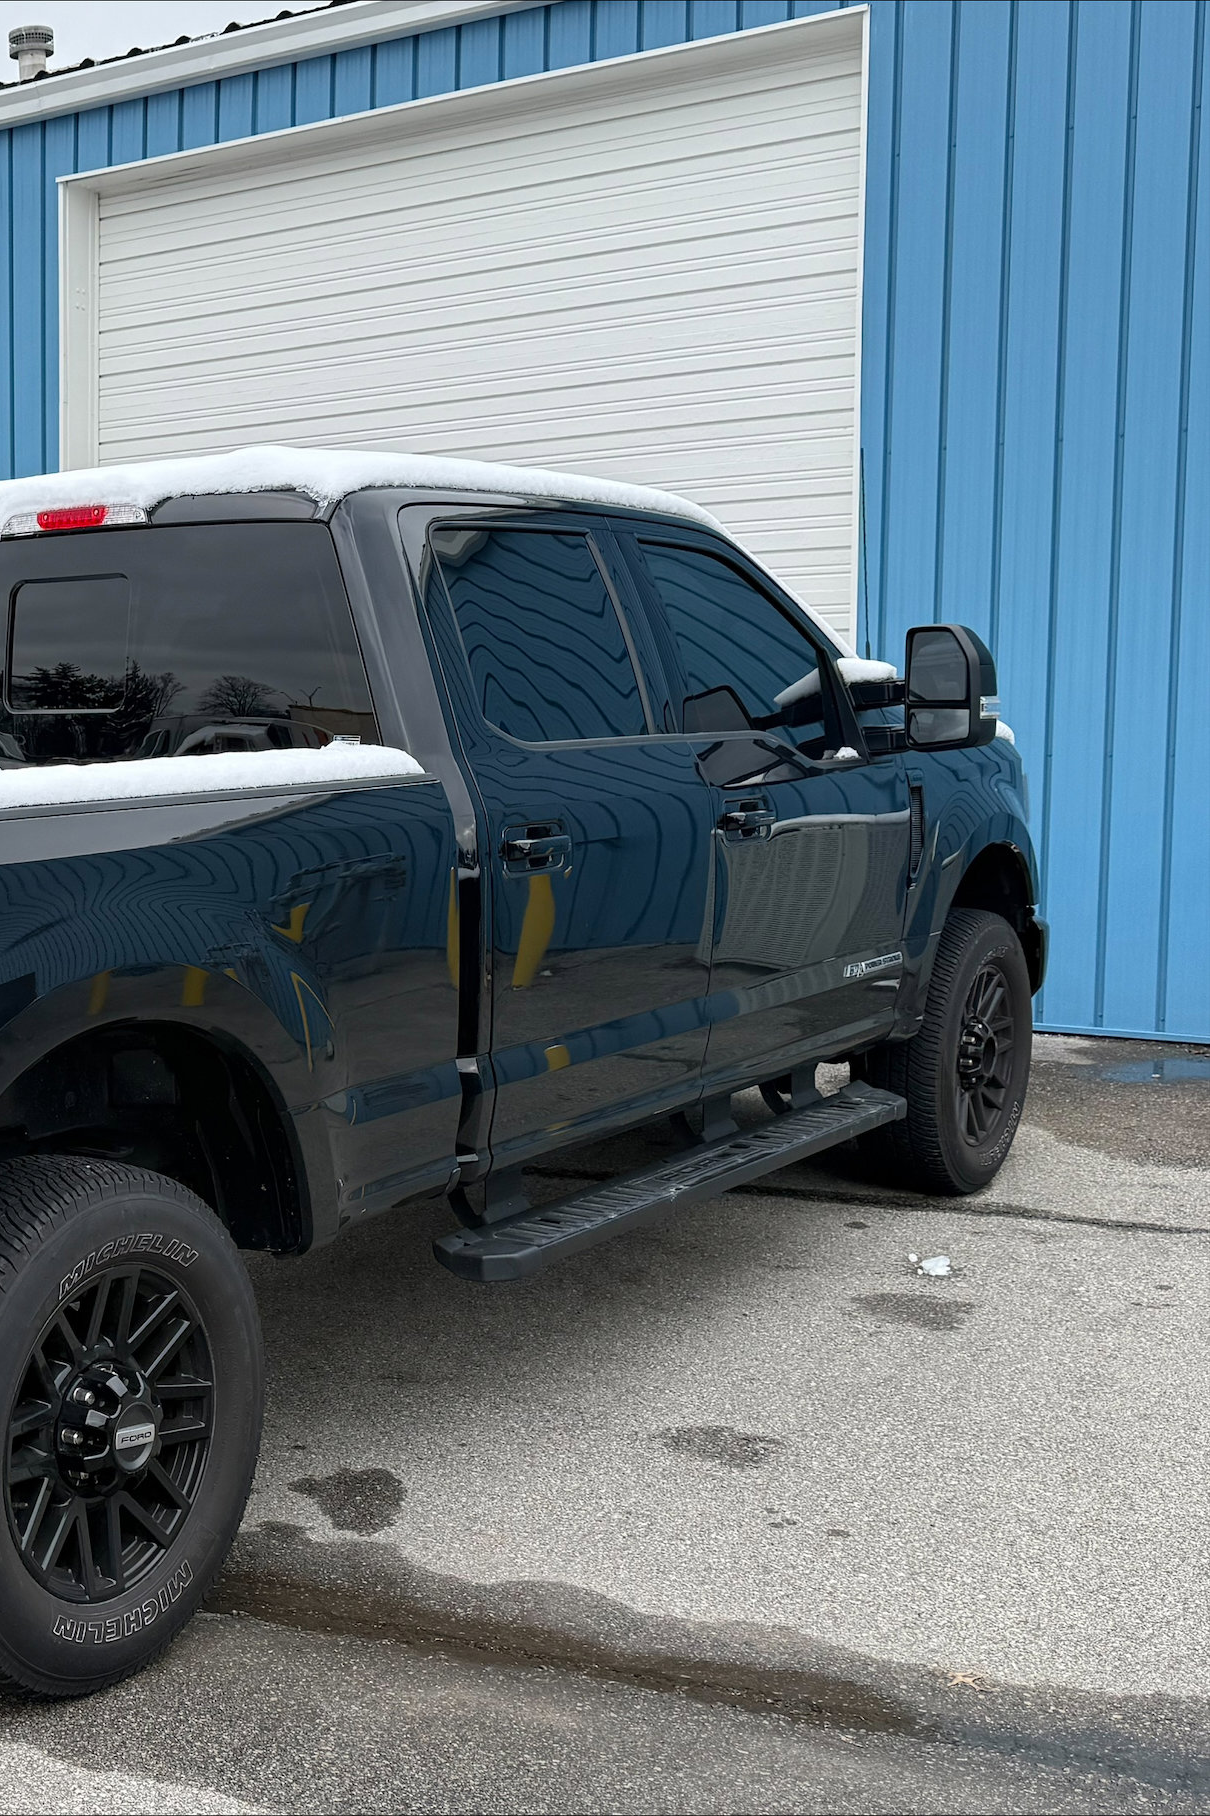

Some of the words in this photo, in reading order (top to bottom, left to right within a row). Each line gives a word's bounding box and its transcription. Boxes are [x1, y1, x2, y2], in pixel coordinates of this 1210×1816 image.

[58, 1233, 199, 1301] MICHELIN
[121, 1431, 152, 1444] FORD
[53, 1559, 194, 1644] MICHELIN
